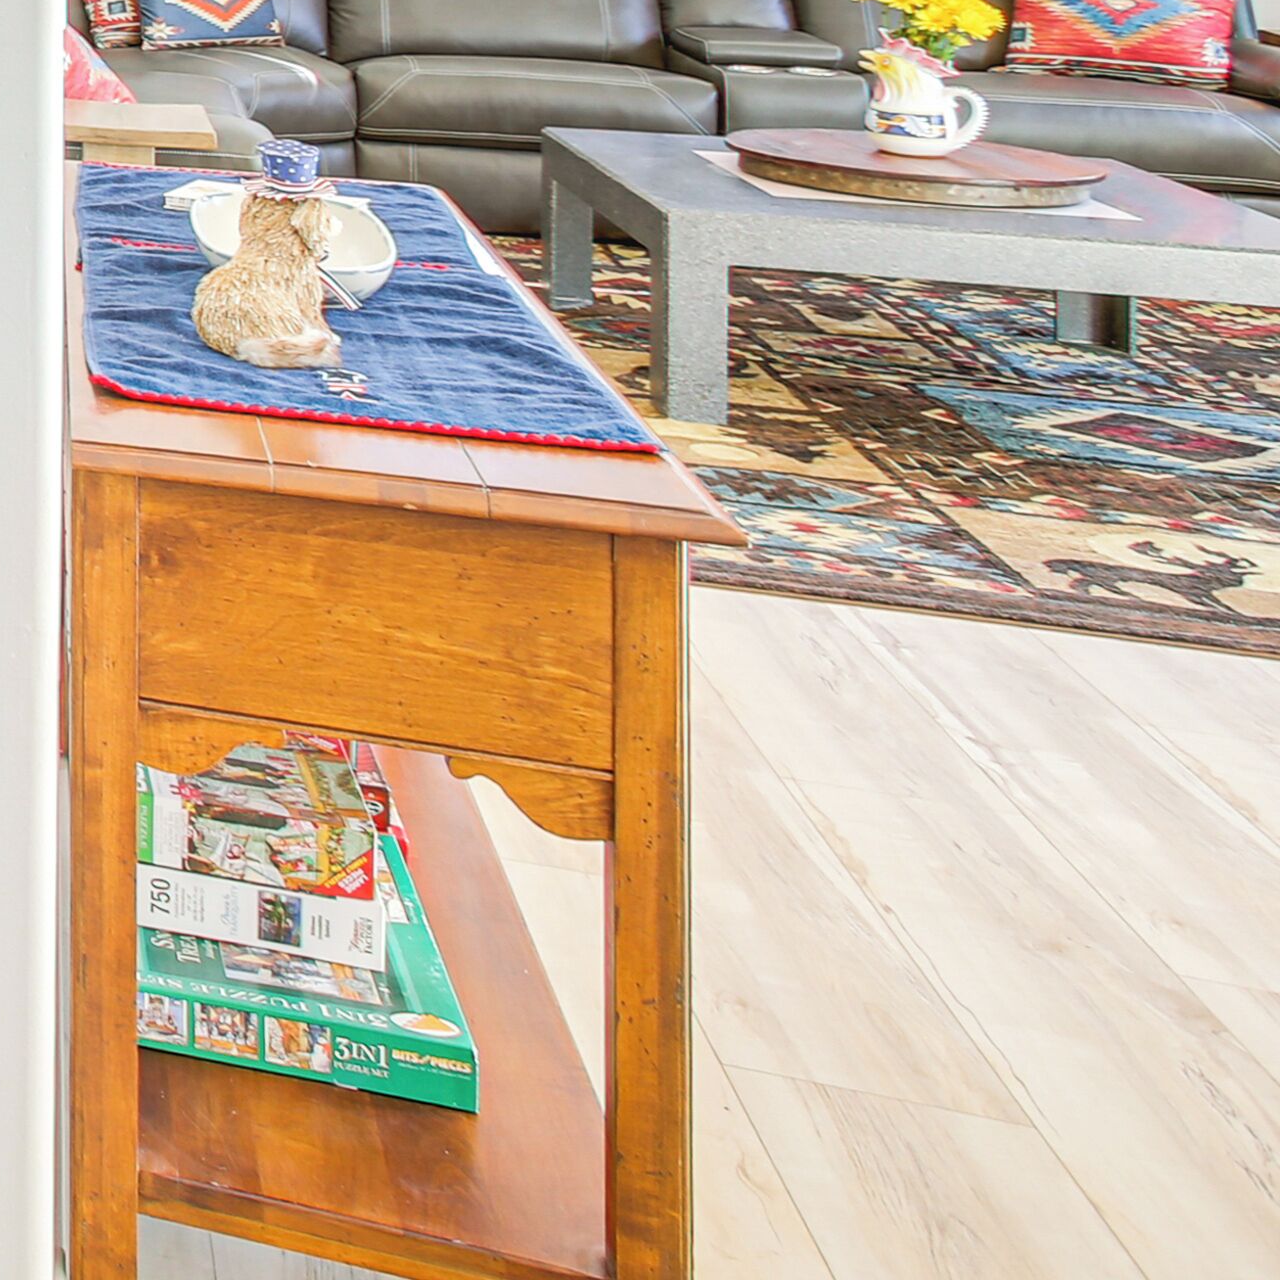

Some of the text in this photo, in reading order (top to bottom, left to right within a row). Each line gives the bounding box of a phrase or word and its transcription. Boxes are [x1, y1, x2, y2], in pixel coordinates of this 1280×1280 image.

[150, 878, 171, 915] 750
[176, 935, 202, 964] TREA
[192, 984, 310, 1013] PUZZLE
